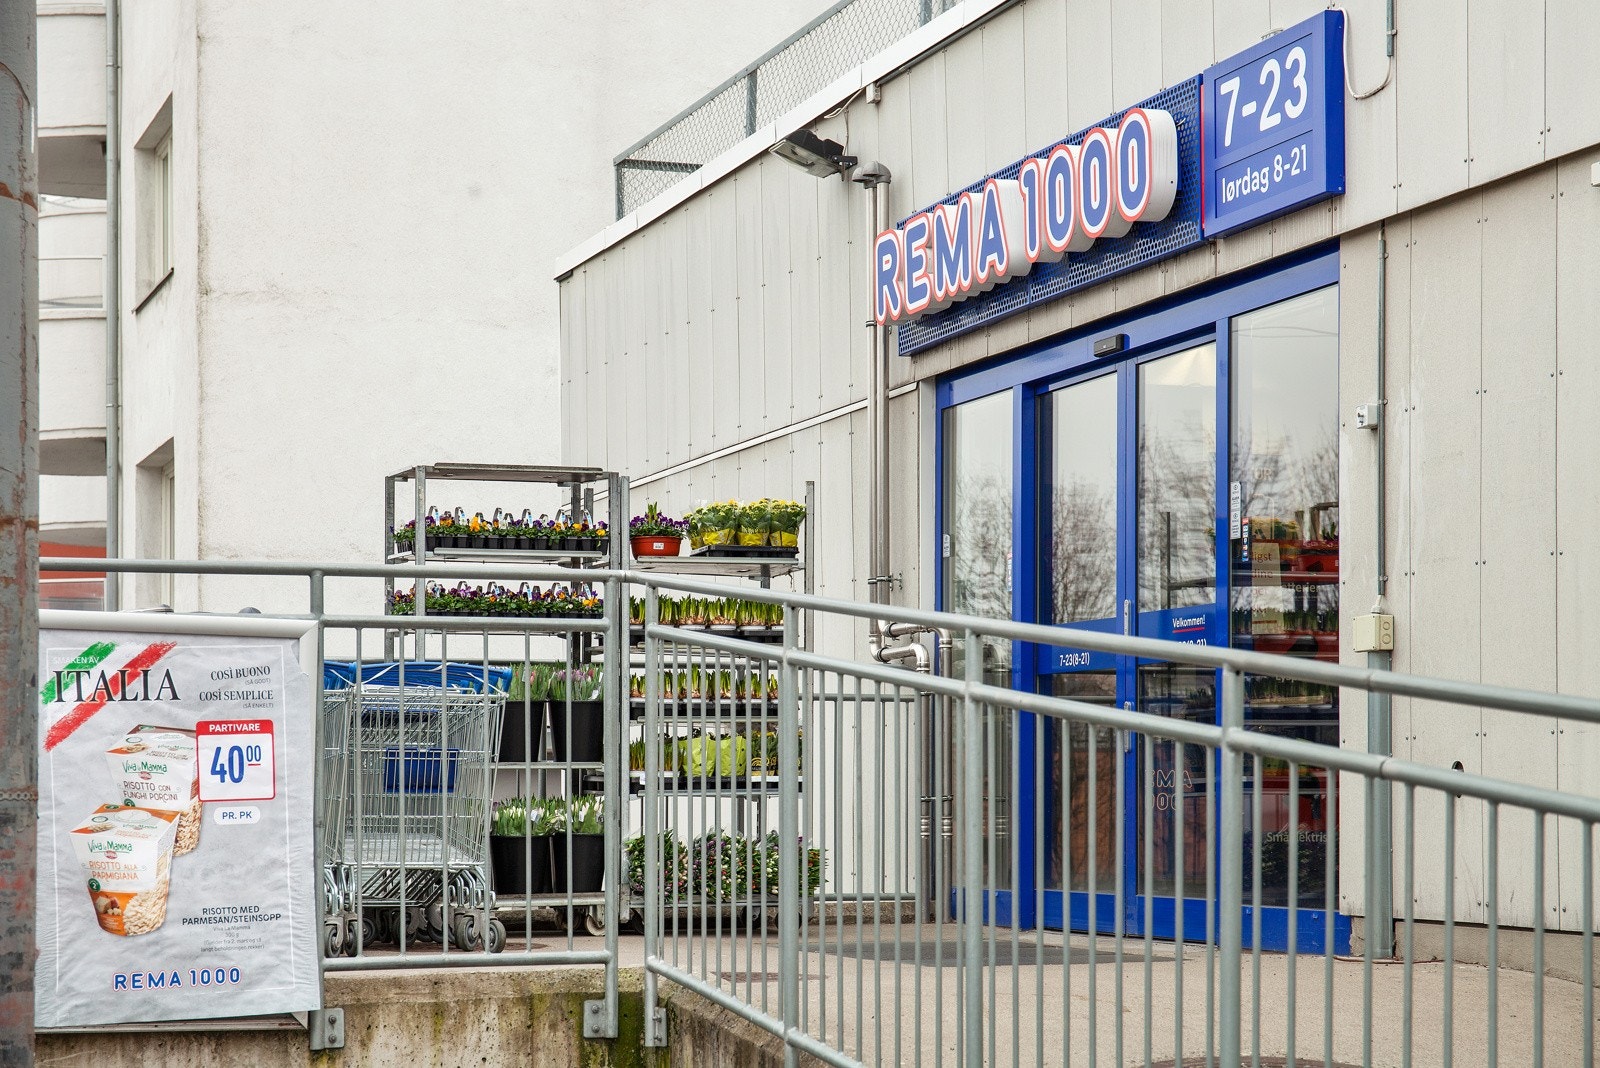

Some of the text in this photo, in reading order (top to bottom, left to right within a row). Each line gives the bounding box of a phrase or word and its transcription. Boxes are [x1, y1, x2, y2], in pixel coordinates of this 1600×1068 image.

[1219, 46, 1308, 148] 7-23
[1222, 143, 1307, 204] lørdag 8-21
[875, 107, 1153, 326] REMA 1000
[1172, 614, 1206, 628] Velkommen!
[1059, 652, 1090, 667] 7-23(8-21)
[211, 665, 271, 682] COSÌ BUONO
[53, 668, 181, 703] ITALIA
[199, 688, 274, 701] COSÌ SEMPLICE
[209, 723, 260, 733] PARTIVARE
[141, 761, 168, 772] Mamma
[123, 781, 155, 791] RISOTTO
[123, 792, 147, 800] FUNGHI
[222, 811, 252, 820] PR. PK
[107, 841, 133, 851] Mamma
[89, 861, 120, 870] RISOTTO
[92, 871, 139, 880] PARMIGIANA
[202, 905, 260, 916] RISOTTO MED
[182, 913, 282, 926] PARMESAN/STEINSOPP
[113, 966, 242, 991] REMA 1000
